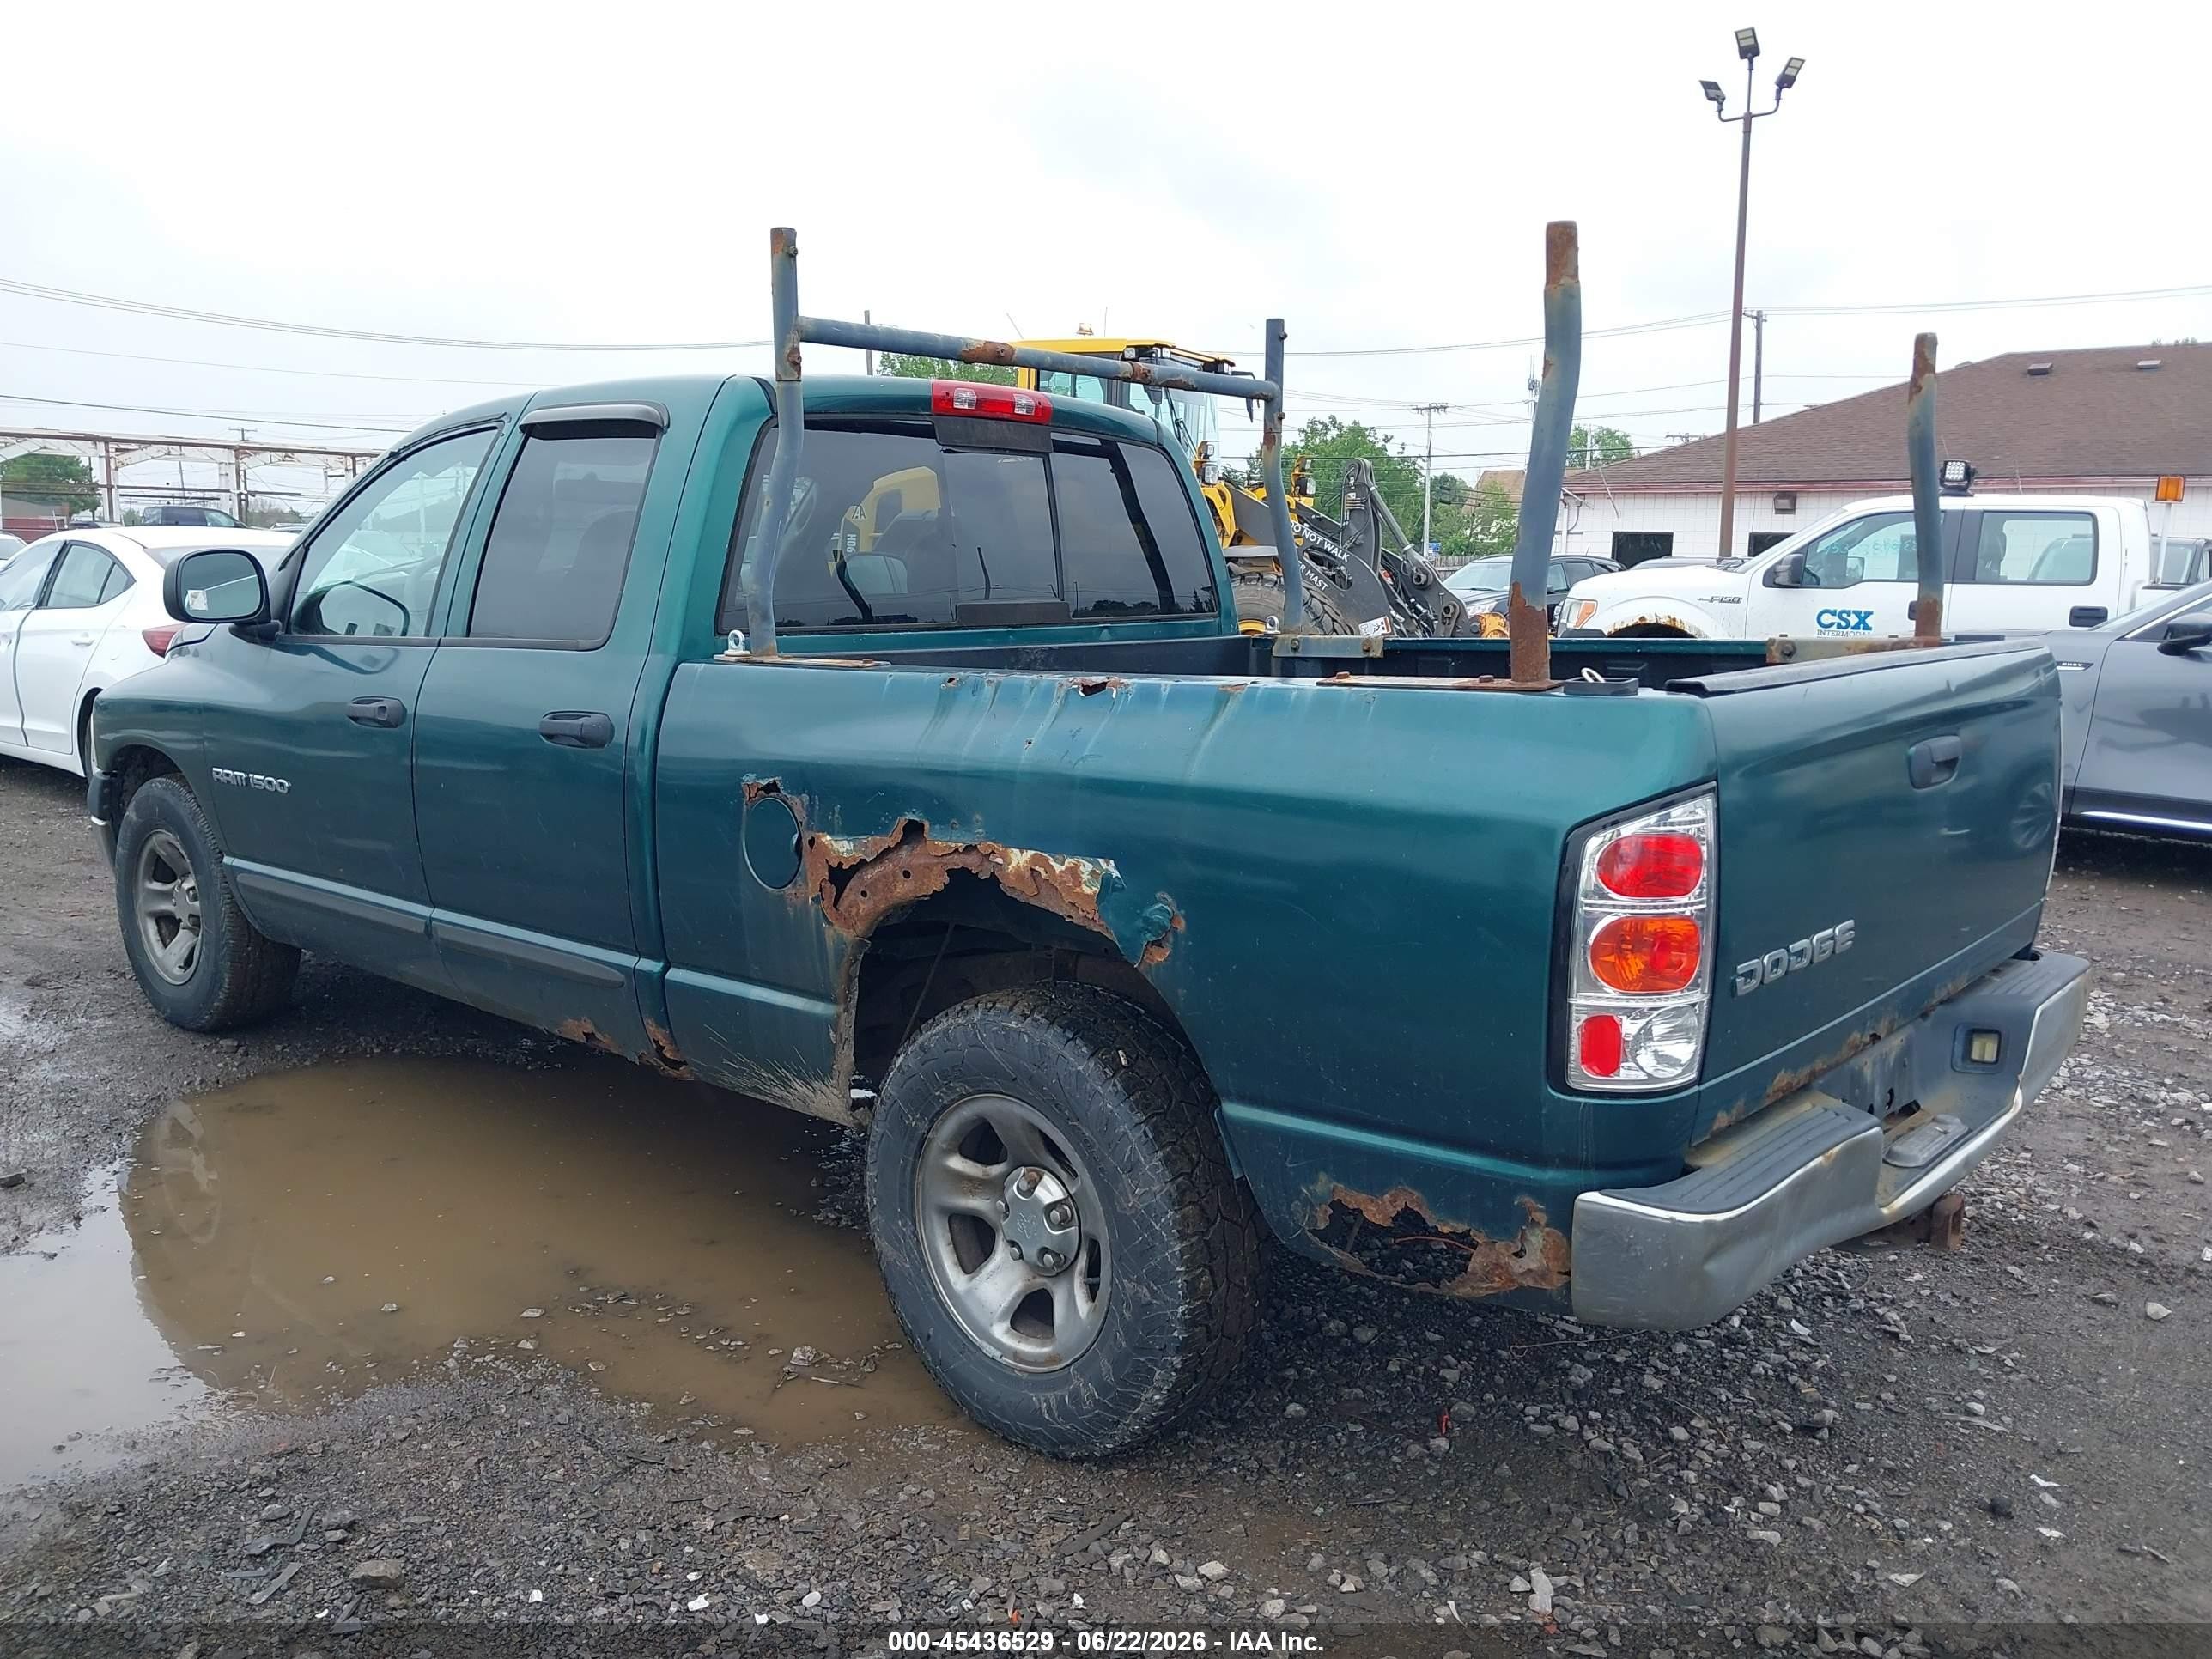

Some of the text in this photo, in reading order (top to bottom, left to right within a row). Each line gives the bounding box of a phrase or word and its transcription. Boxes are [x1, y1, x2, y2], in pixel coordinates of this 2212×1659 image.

[1302, 528, 1323, 545] NOT
[1323, 540, 1351, 562] WALK
[1305, 569, 1329, 591] MAST
[1816, 608, 1875, 631] CSX
[212, 767, 291, 794] RAM 1500
[1734, 918, 1856, 997] DODGE
